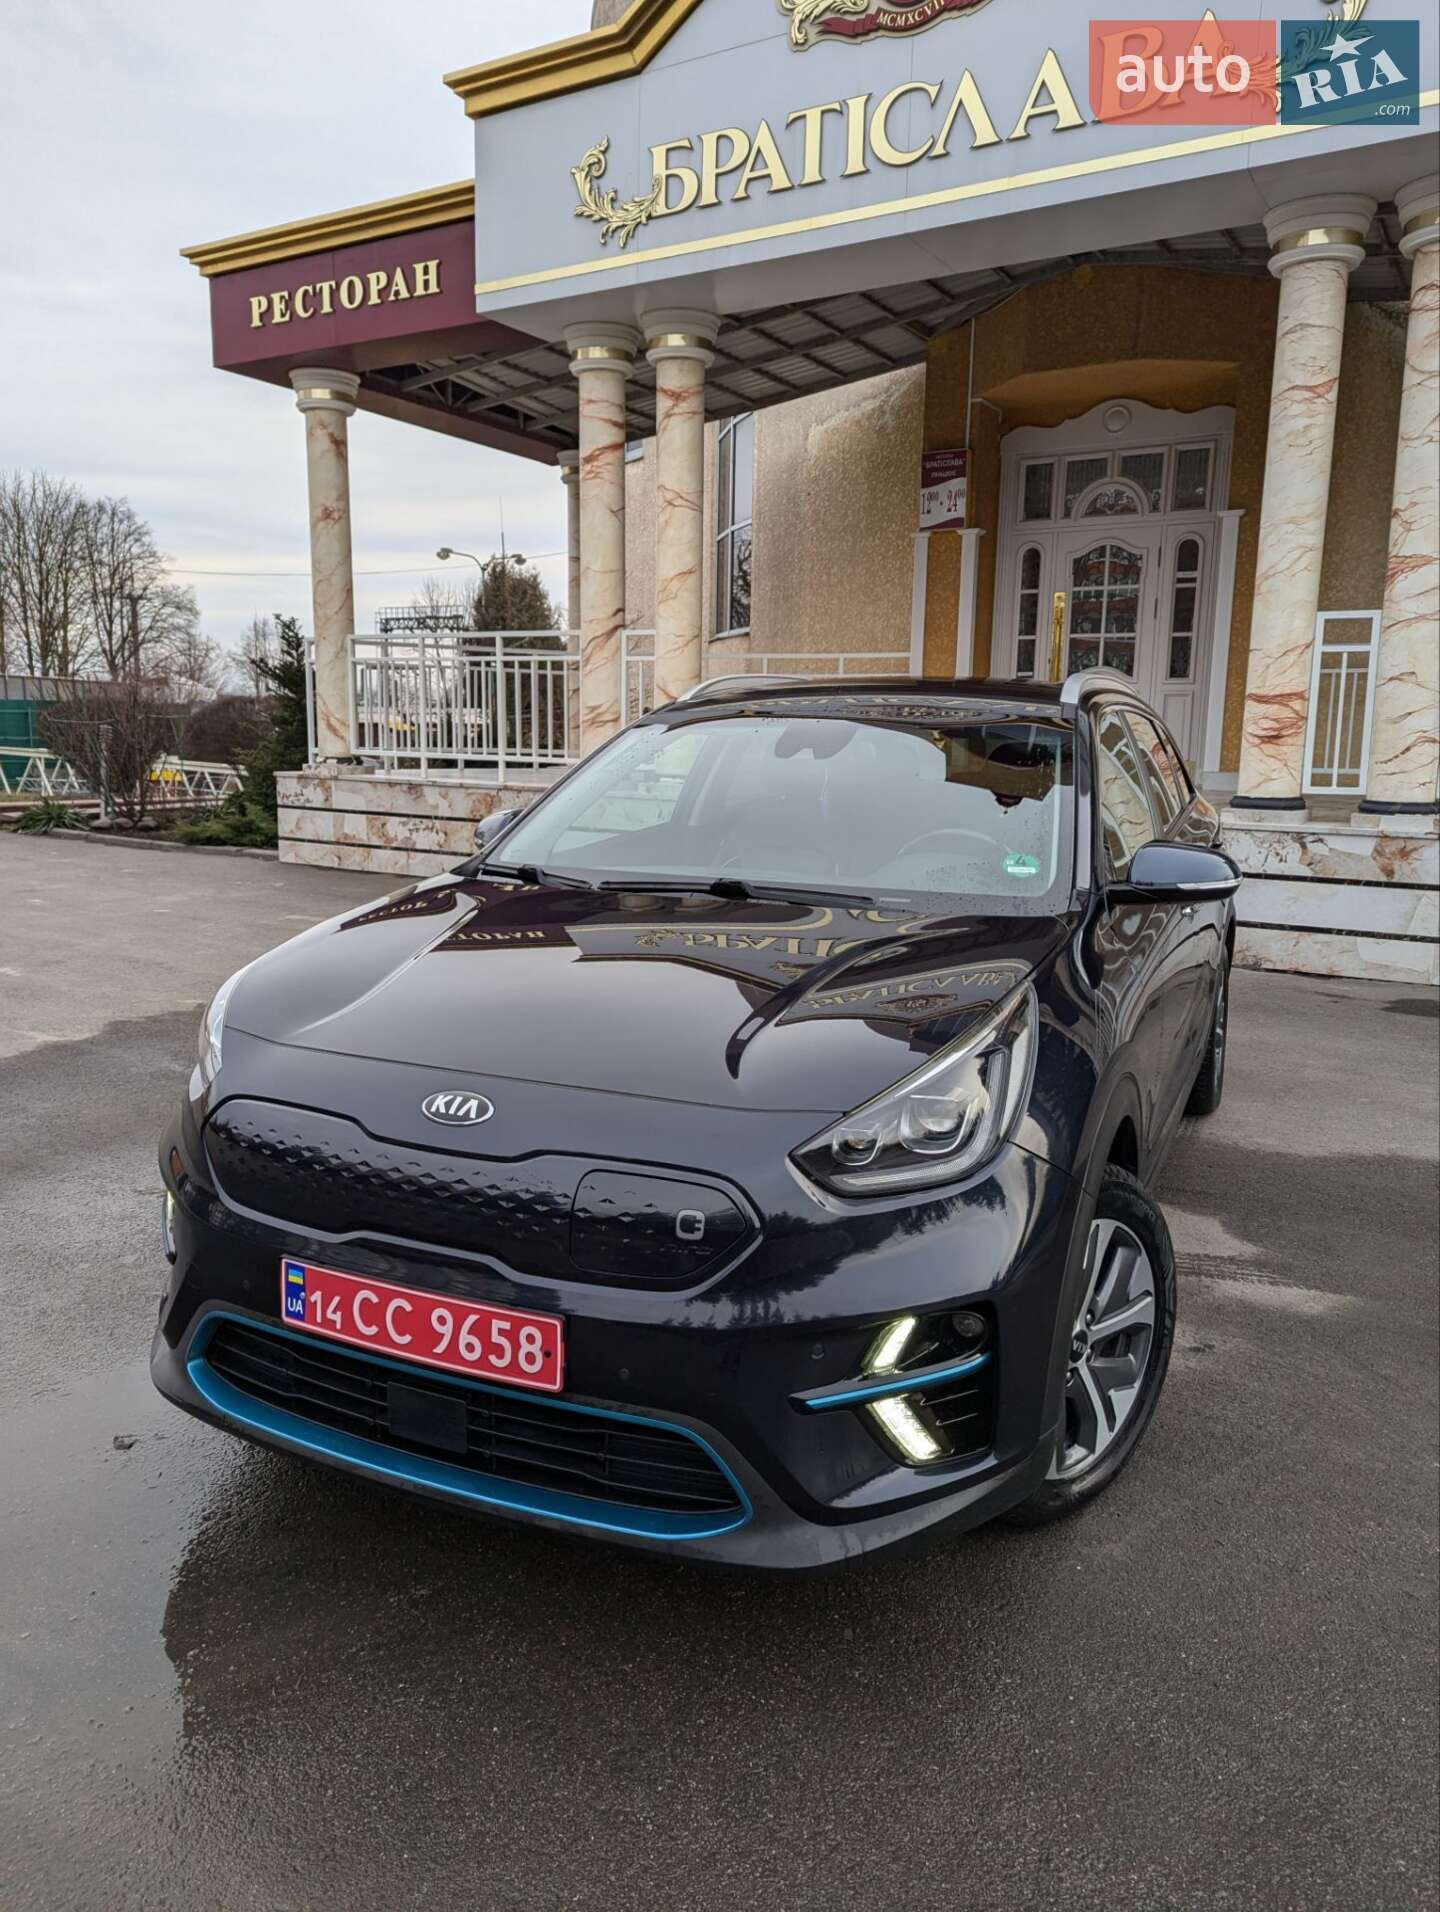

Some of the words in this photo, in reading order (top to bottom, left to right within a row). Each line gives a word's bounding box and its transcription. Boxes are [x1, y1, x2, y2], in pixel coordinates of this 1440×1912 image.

[249, 259, 441, 329] РЕСТОРАН
[430, 1094, 479, 1119] KIA
[287, 1296, 304, 1315] UA
[310, 1290, 342, 1330] 14
[352, 1289, 413, 1345] CC
[430, 1307, 544, 1374] 9658
